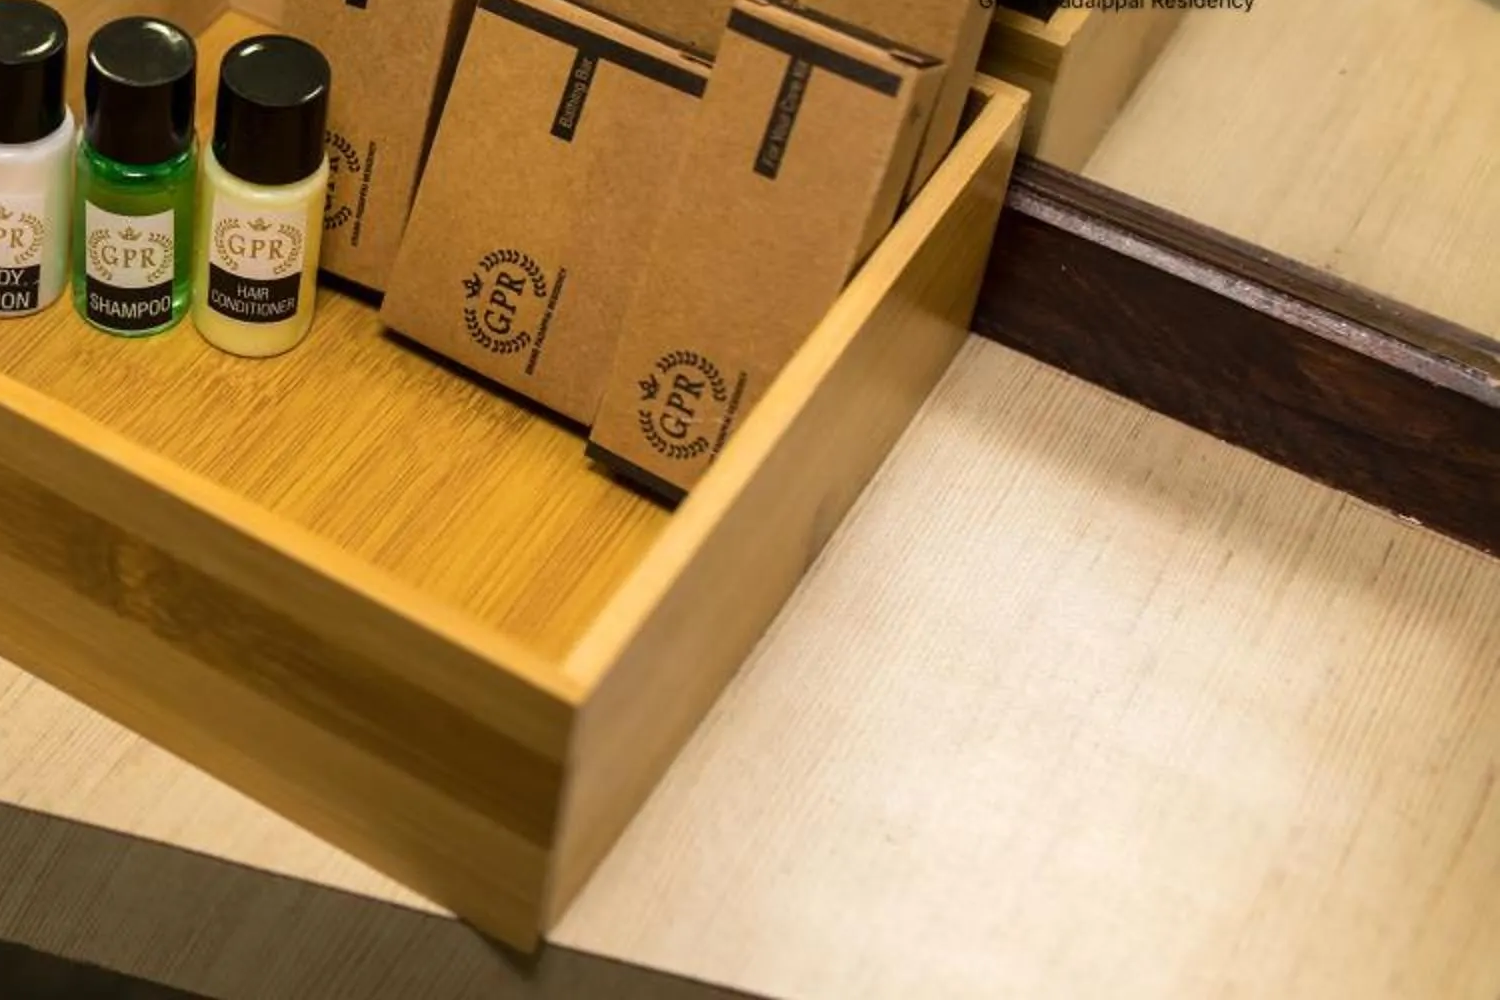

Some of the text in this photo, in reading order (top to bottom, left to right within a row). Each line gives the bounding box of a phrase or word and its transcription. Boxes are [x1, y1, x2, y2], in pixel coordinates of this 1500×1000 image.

[559, 81, 587, 129] Bathing
[101, 245, 156, 268] GPR
[228, 233, 284, 260] GPR
[211, 289, 295, 316] CONDITIONER
[237, 283, 269, 300] HAIR
[484, 272, 527, 334] GPR
[90, 293, 170, 318] SHAMPOO
[660, 374, 705, 438] GPR
